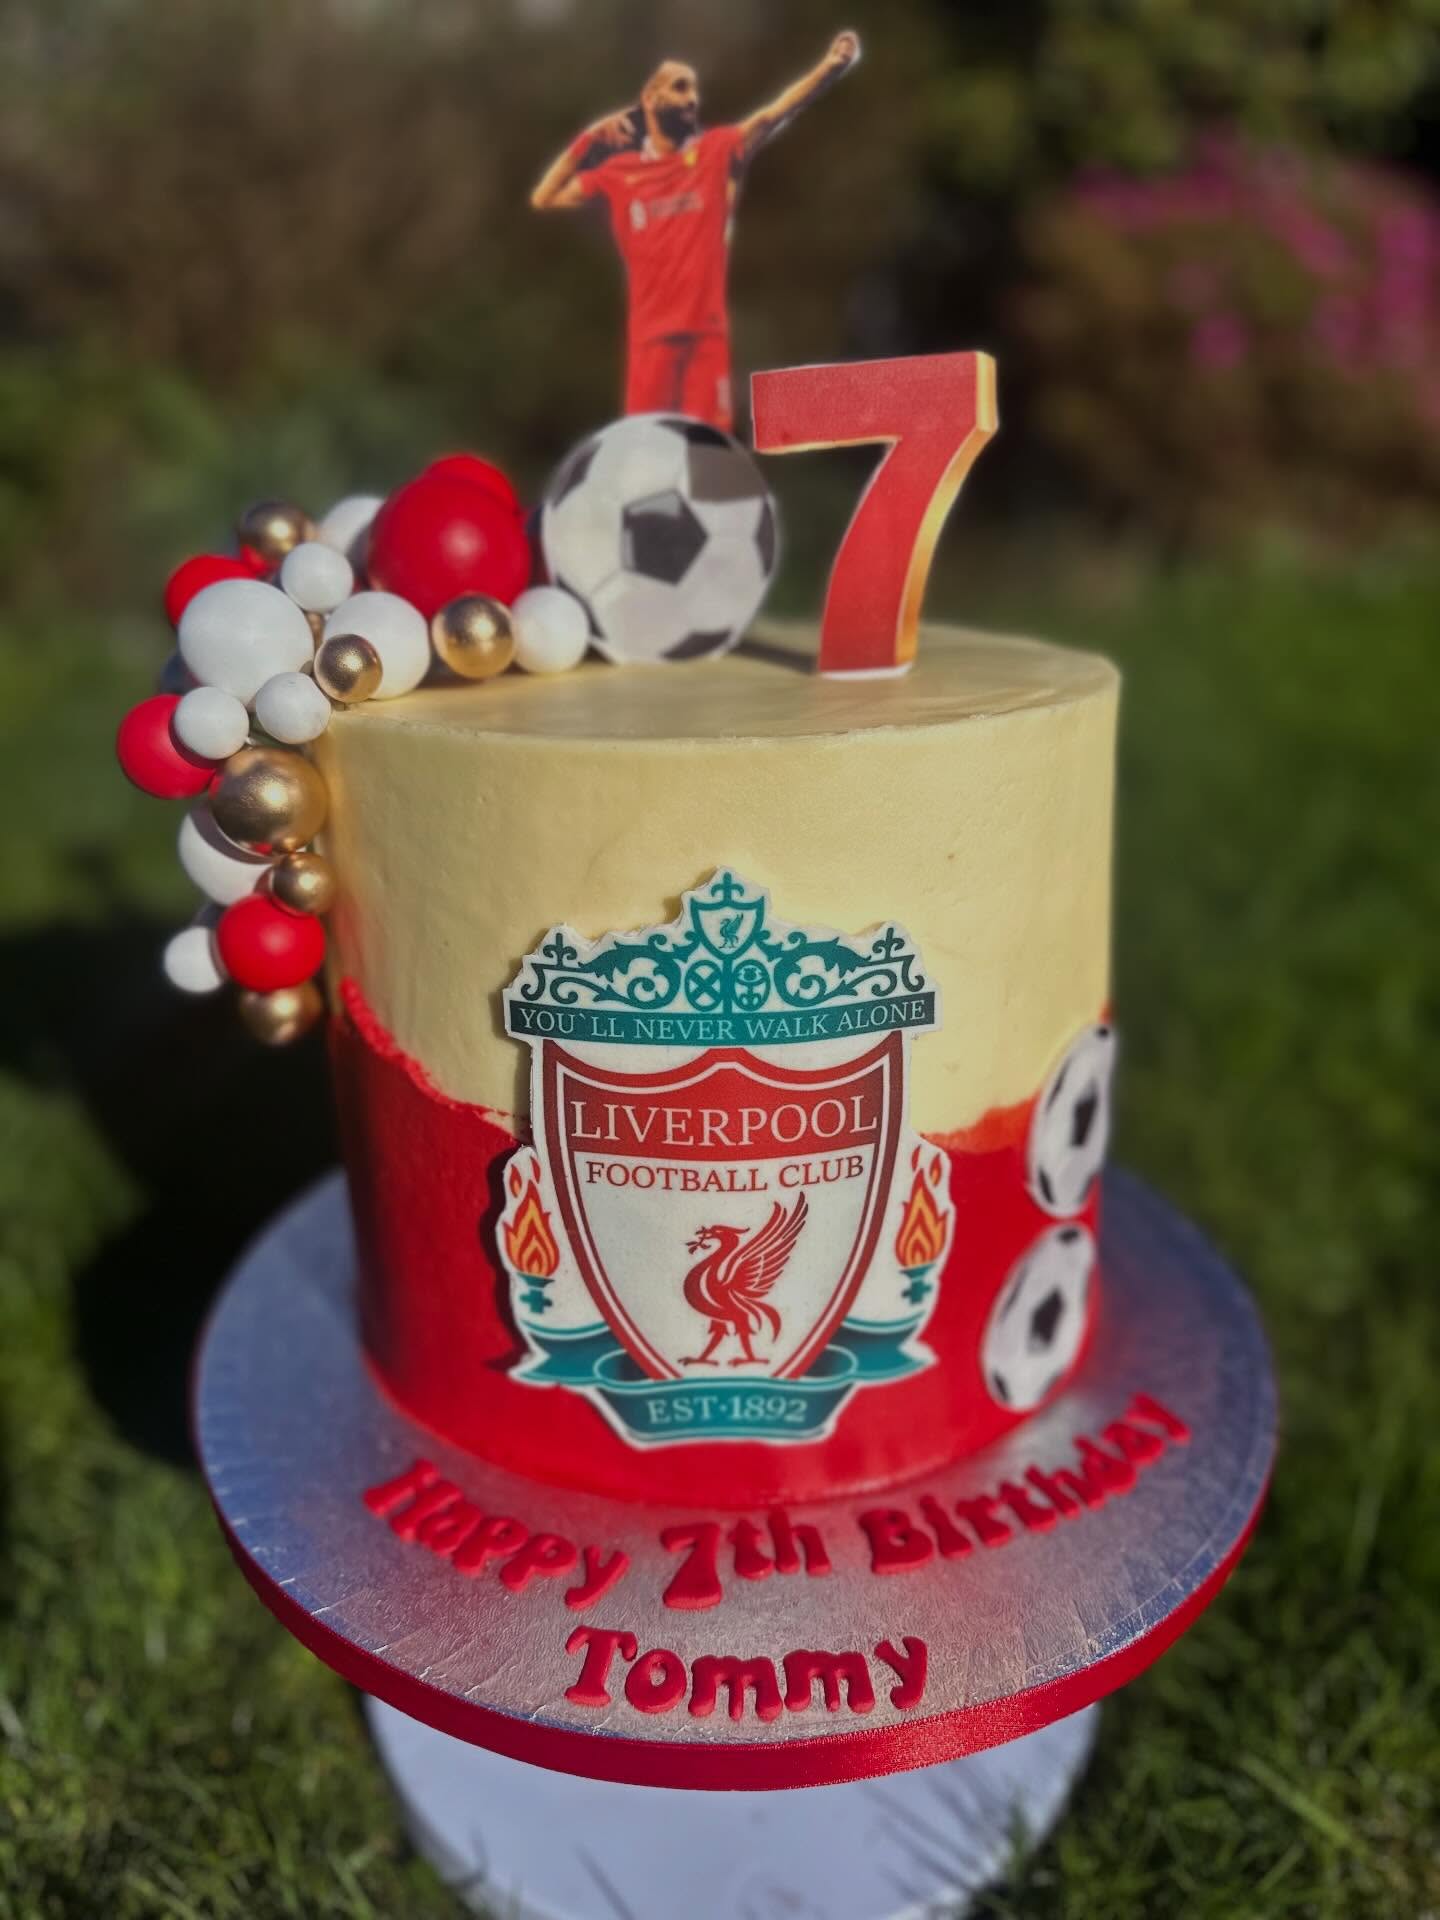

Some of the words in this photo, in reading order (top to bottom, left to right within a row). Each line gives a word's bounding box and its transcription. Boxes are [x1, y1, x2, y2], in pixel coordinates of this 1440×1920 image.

[751, 351, 998, 680] 7
[633, 1017, 737, 1041] NEVER
[744, 1012, 831, 1040] WALK
[835, 999, 926, 1033] ALONE
[569, 1095, 879, 1148] LIVERPOOL
[585, 1160, 769, 1193] FOOTBALL
[778, 1154, 865, 1186] CLUB
[363, 1459, 631, 1612] Happy
[660, 1503, 832, 1611] 7th
[856, 1390, 1192, 1576] Birthday
[564, 1624, 928, 1723] Tommy
